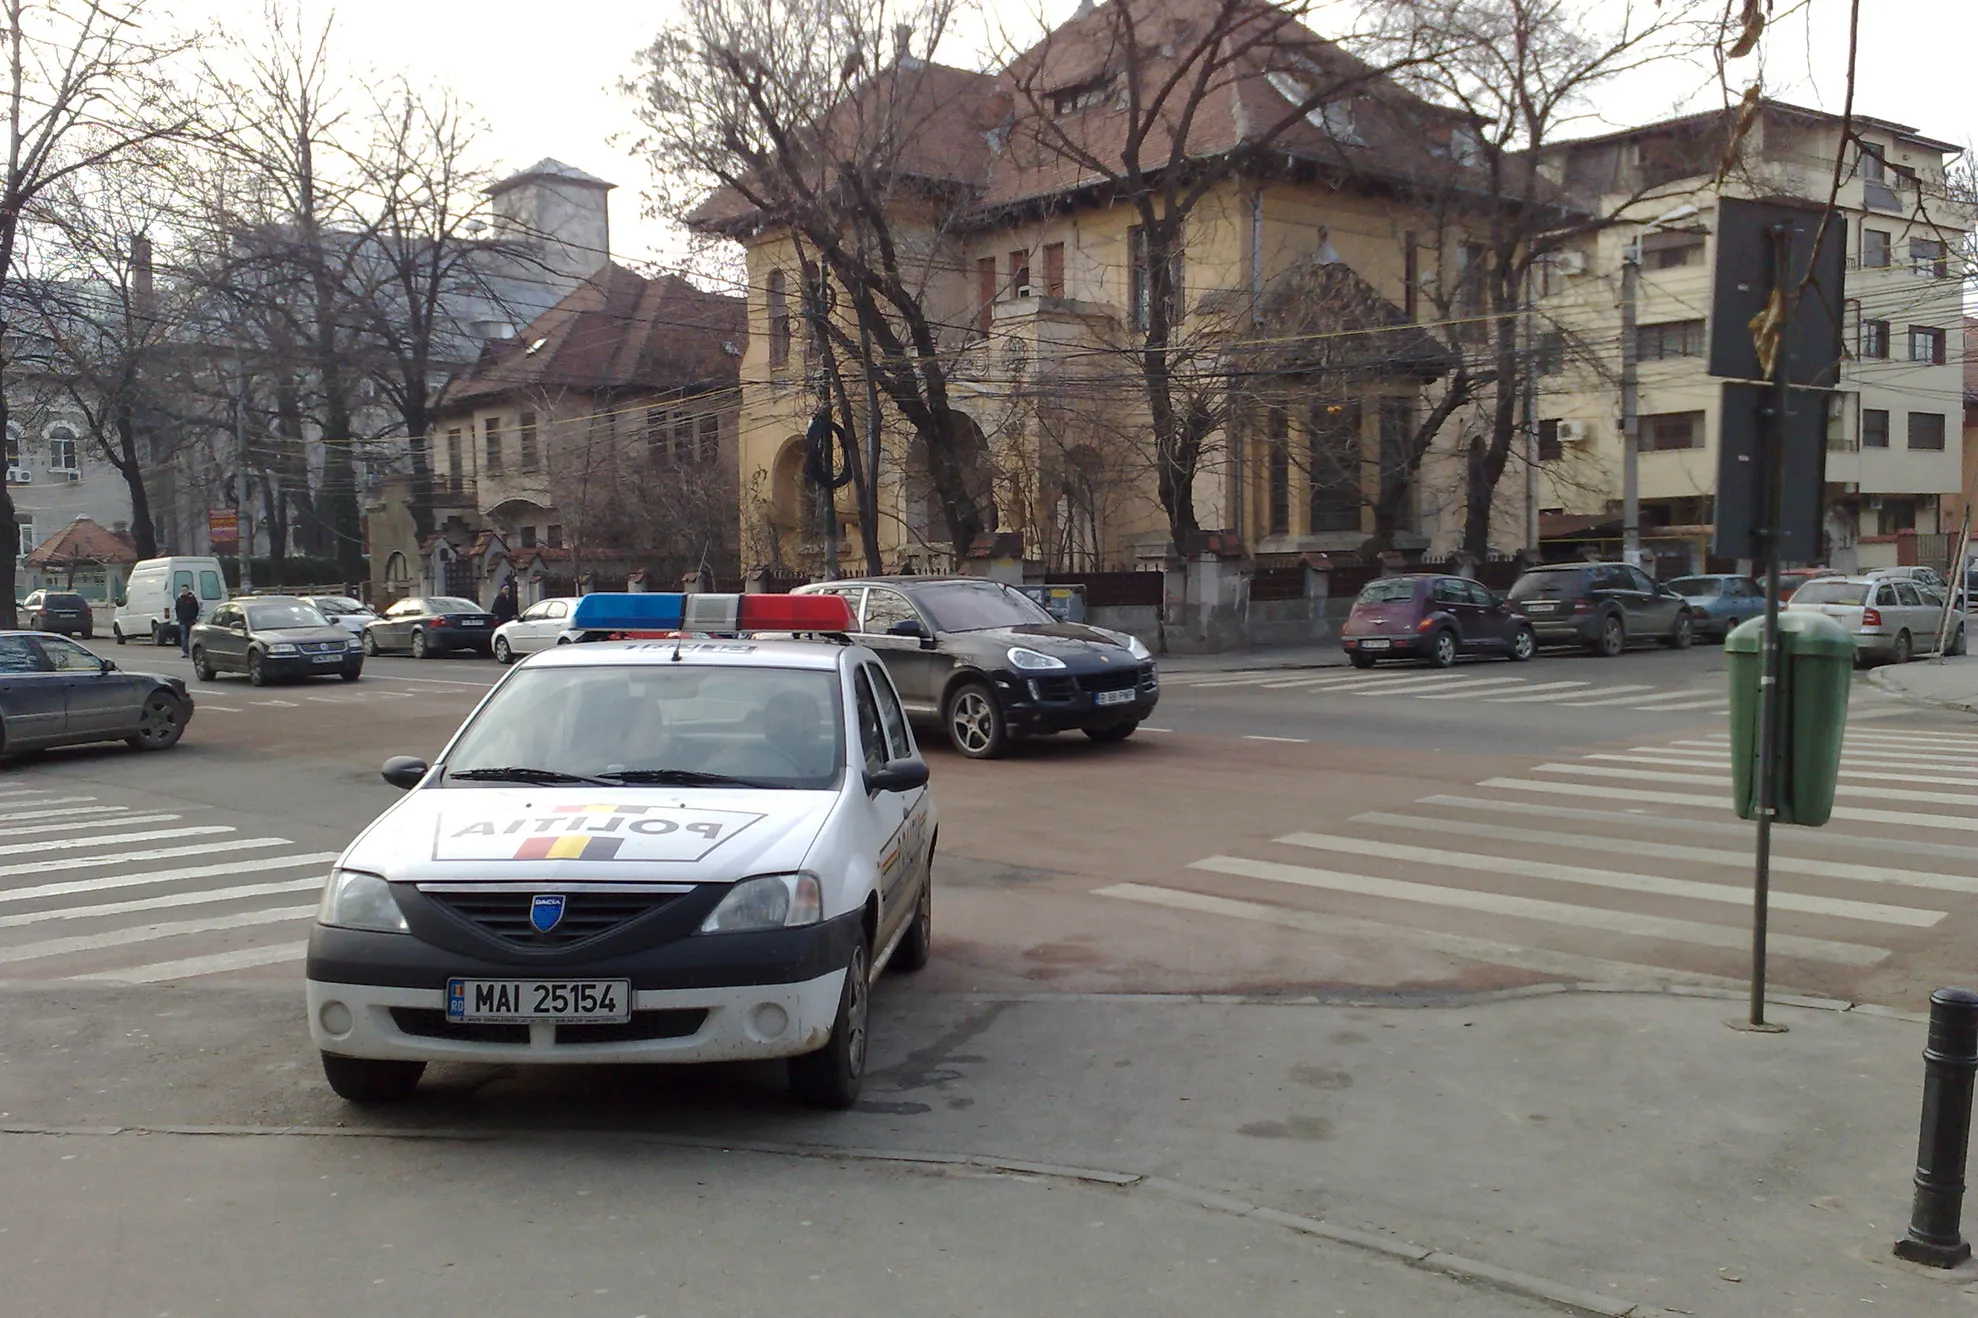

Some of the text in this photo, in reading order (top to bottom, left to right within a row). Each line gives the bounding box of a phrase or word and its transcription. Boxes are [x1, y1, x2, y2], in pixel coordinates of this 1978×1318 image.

[451, 1000, 464, 1012] RO
[475, 984, 616, 1013] MAI 25154
